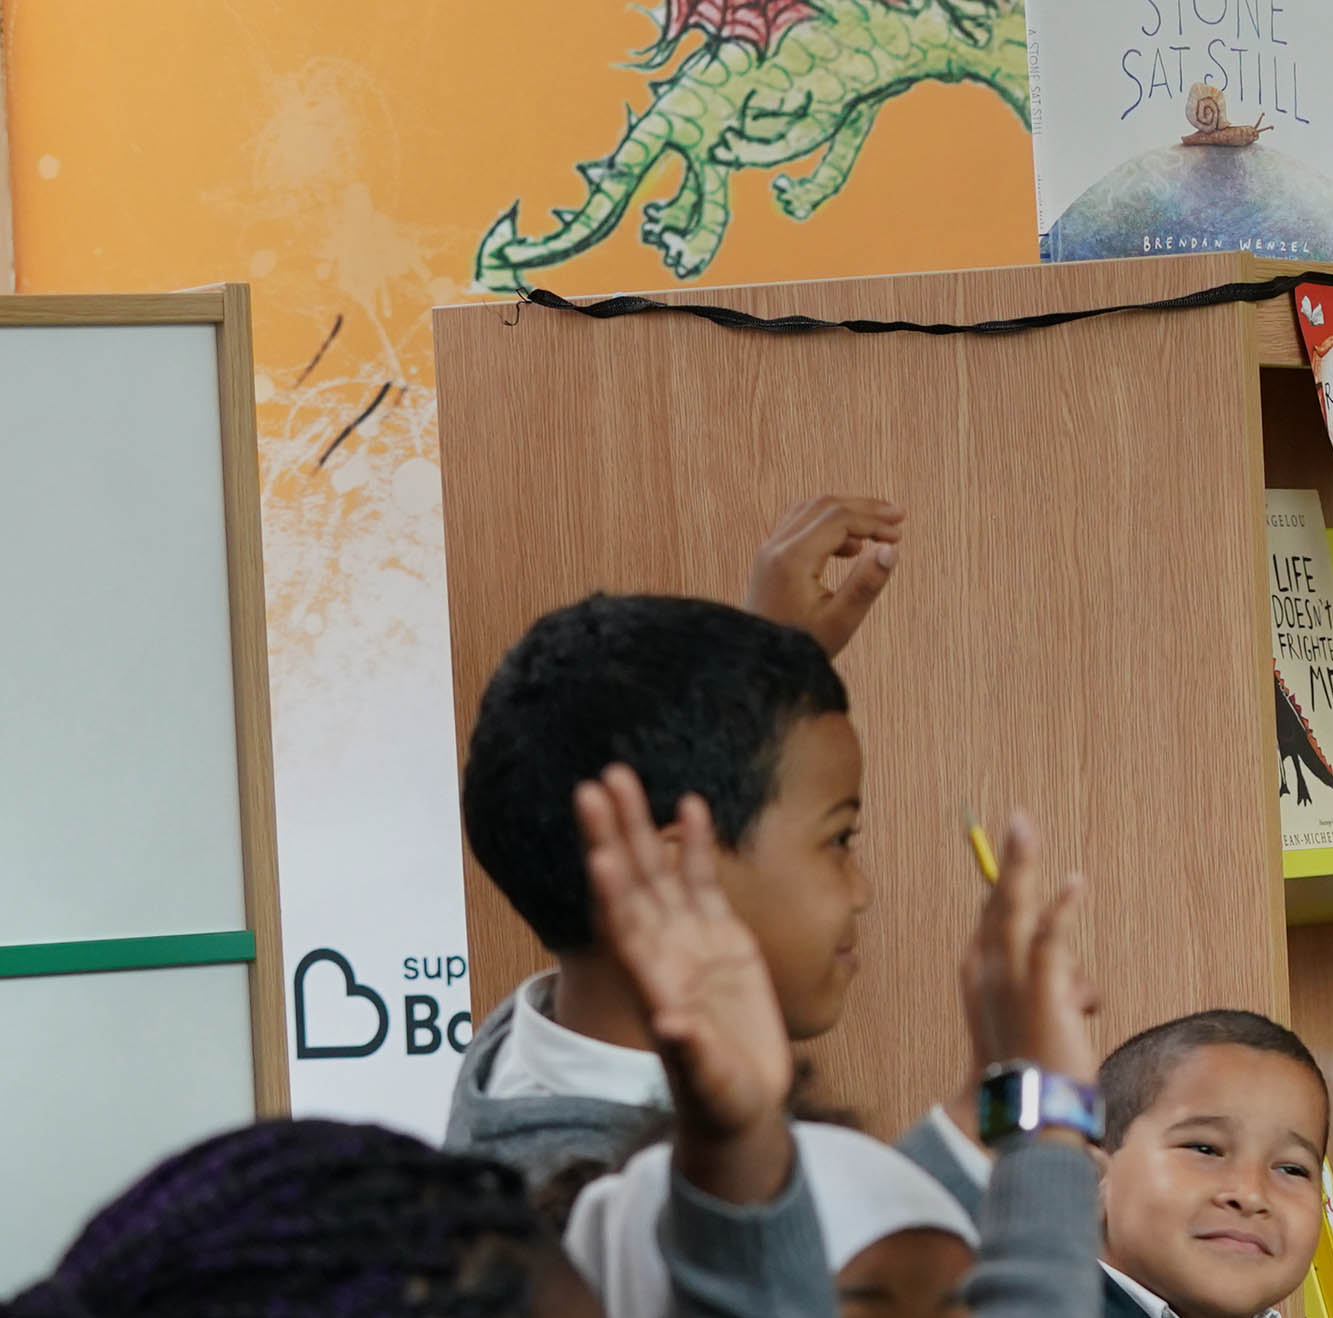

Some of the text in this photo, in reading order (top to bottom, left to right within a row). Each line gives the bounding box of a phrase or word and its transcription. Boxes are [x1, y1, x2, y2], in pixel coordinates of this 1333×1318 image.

[1121, 39, 1310, 124] SAT STILL
[1143, 236, 1311, 253] BRENDAN WENZEL
[1272, 553, 1316, 593] LIFE
